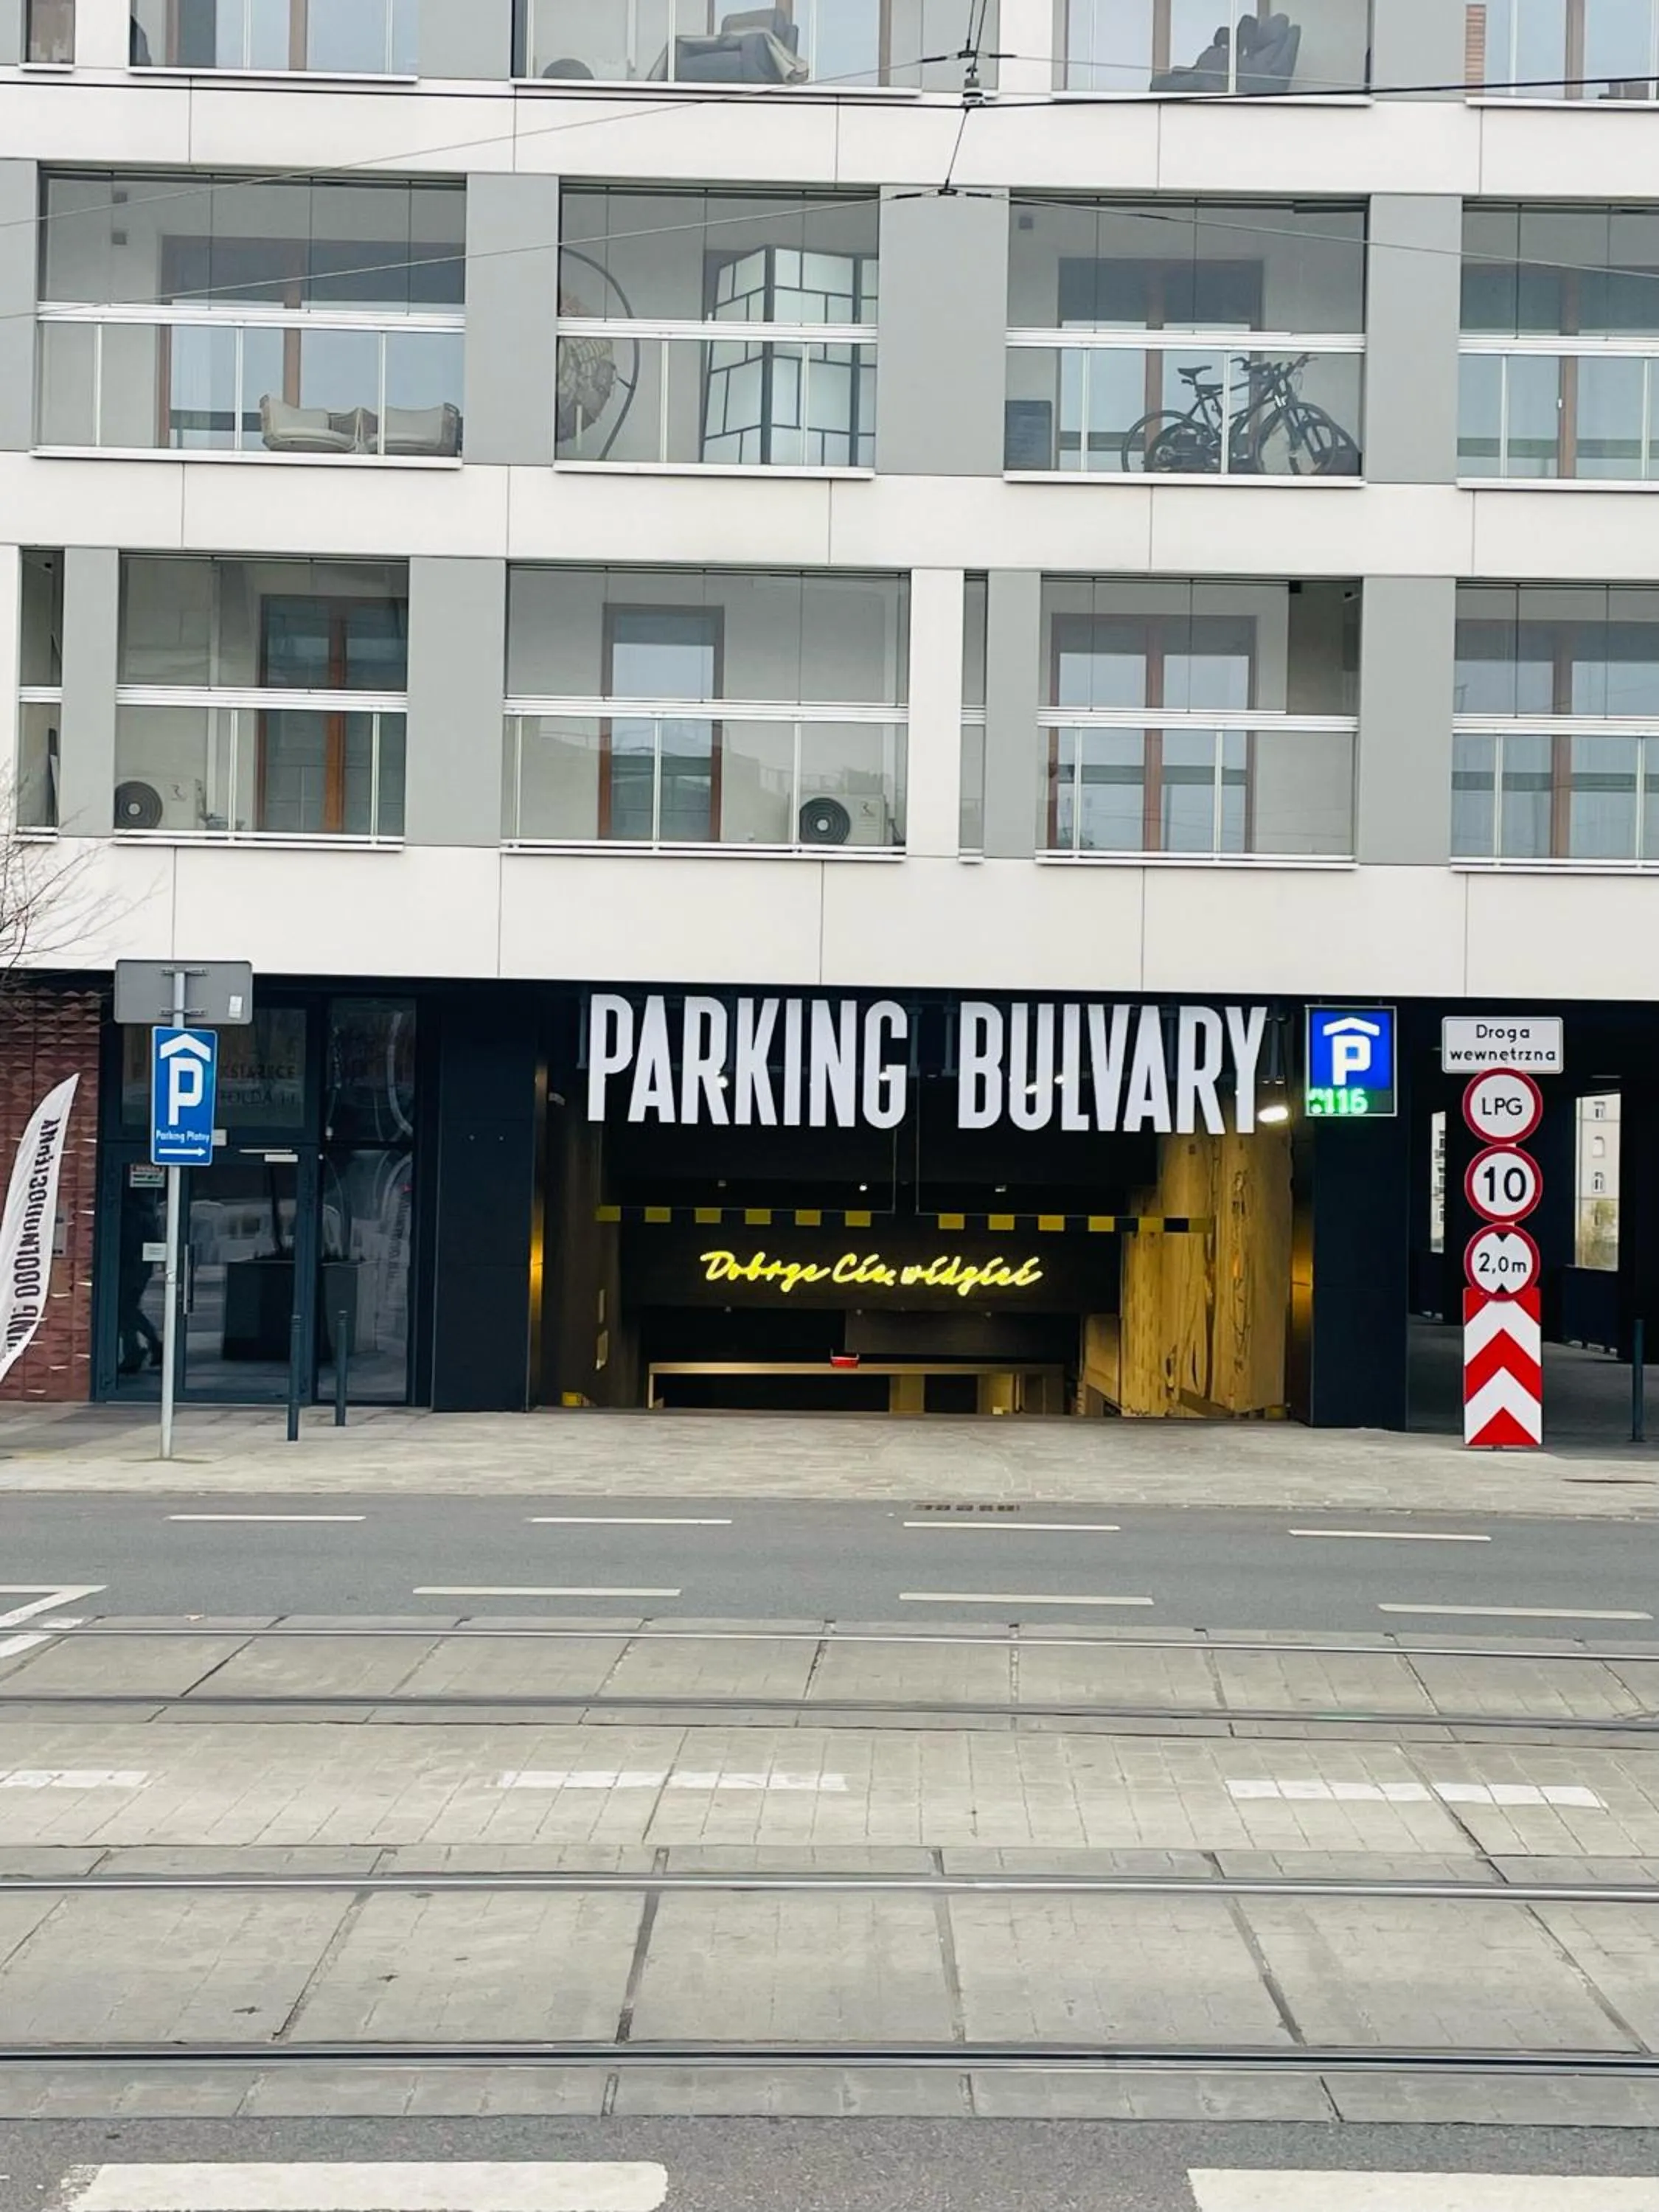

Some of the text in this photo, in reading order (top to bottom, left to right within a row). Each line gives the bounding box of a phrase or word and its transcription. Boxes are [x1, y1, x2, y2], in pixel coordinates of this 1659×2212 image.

[1475, 1023, 1530, 1043] Droga
[588, 993, 1268, 1135] PARKING BULVARY
[1332, 1035, 1371, 1085] P
[168, 1057, 204, 1126] P
[1481, 1097, 1523, 1116] LPG
[156, 1129, 185, 1144] Parking
[1483, 1166, 1527, 1203] 10
